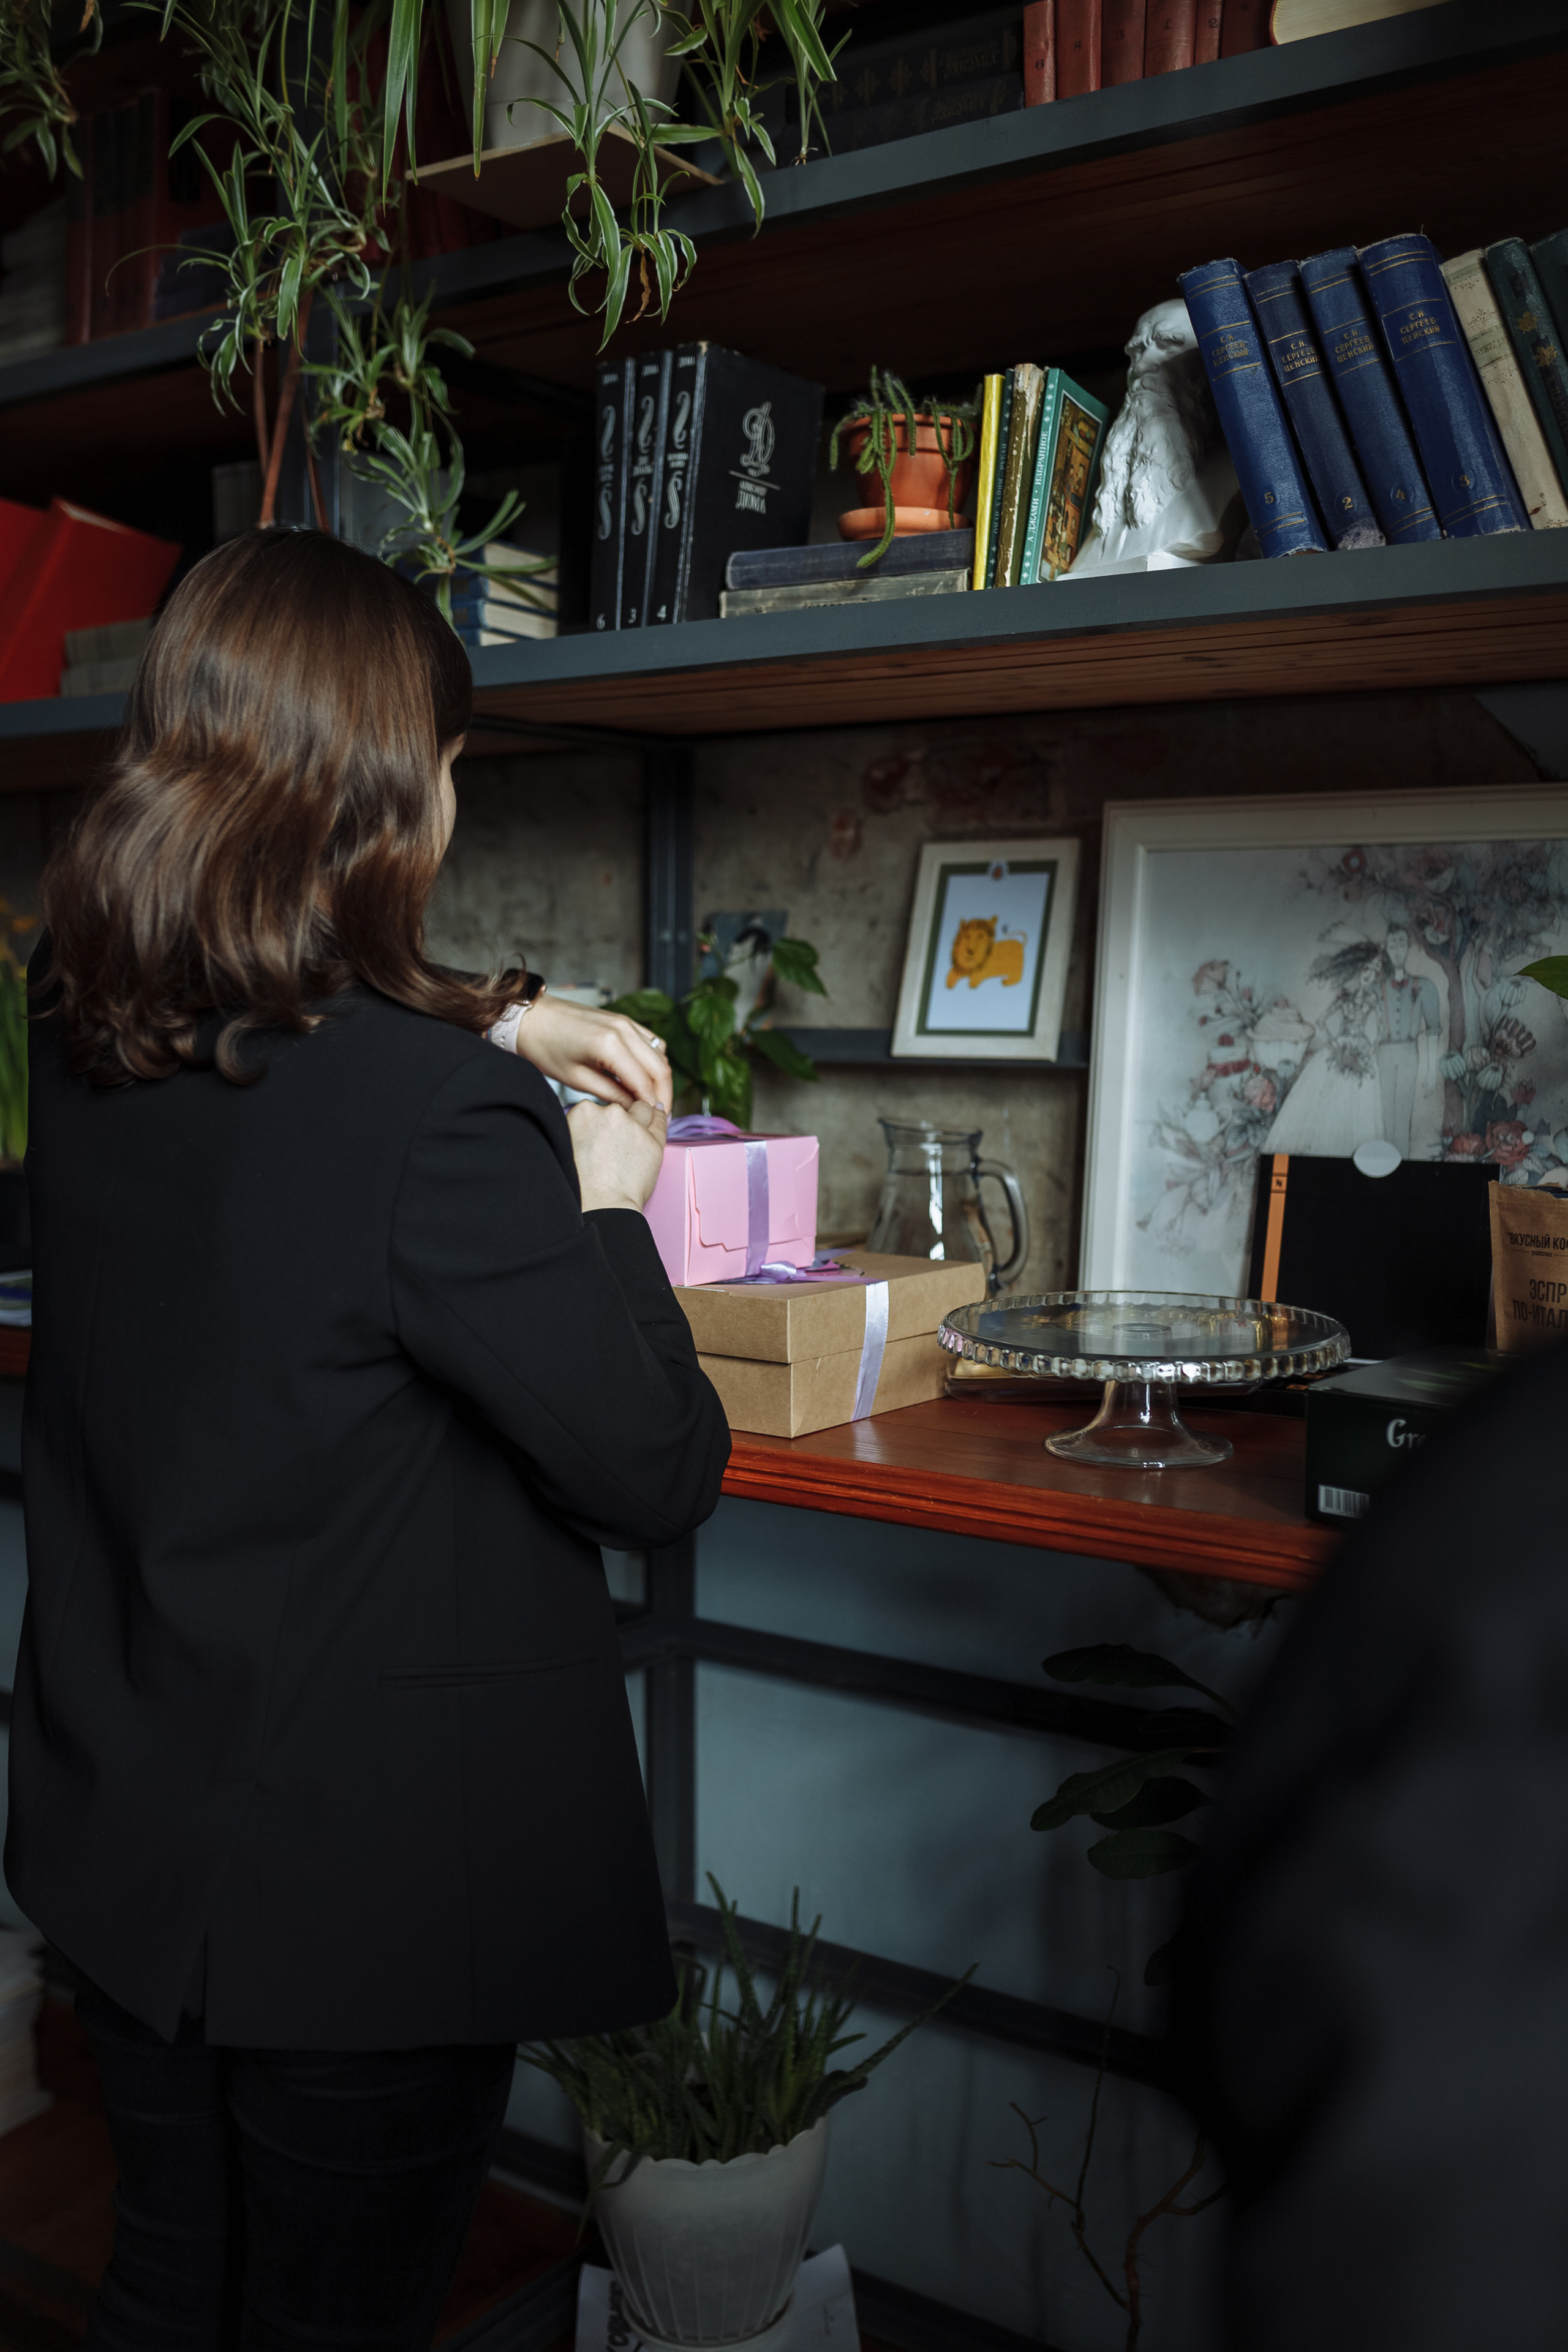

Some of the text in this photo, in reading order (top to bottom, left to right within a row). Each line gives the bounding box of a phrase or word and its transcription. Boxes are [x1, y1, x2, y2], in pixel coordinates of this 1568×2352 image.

[1208, 18, 1218, 28] 2
[1116, 29, 1125, 40] 3
[1401, 324, 1441, 344] ЦЕНСКИЙ
[1213, 349, 1248, 367] ЦЕНСКИЙ
[1336, 342, 1374, 363] ЦЕНСКИЙ
[1035, 430, 1048, 486] ИЗБРАННОЕ
[1459, 475, 1470, 487] 3
[735, 489, 766, 514] ДЮМА
[1264, 492, 1275, 504] 5
[1395, 489, 1406, 500] 4
[1341, 497, 1354, 510] 2
[597, 612, 605, 630] 6
[628, 607, 637, 624] 3
[657, 604, 667, 621] 4
[1529, 1278, 1567, 1303] ЭСПР
